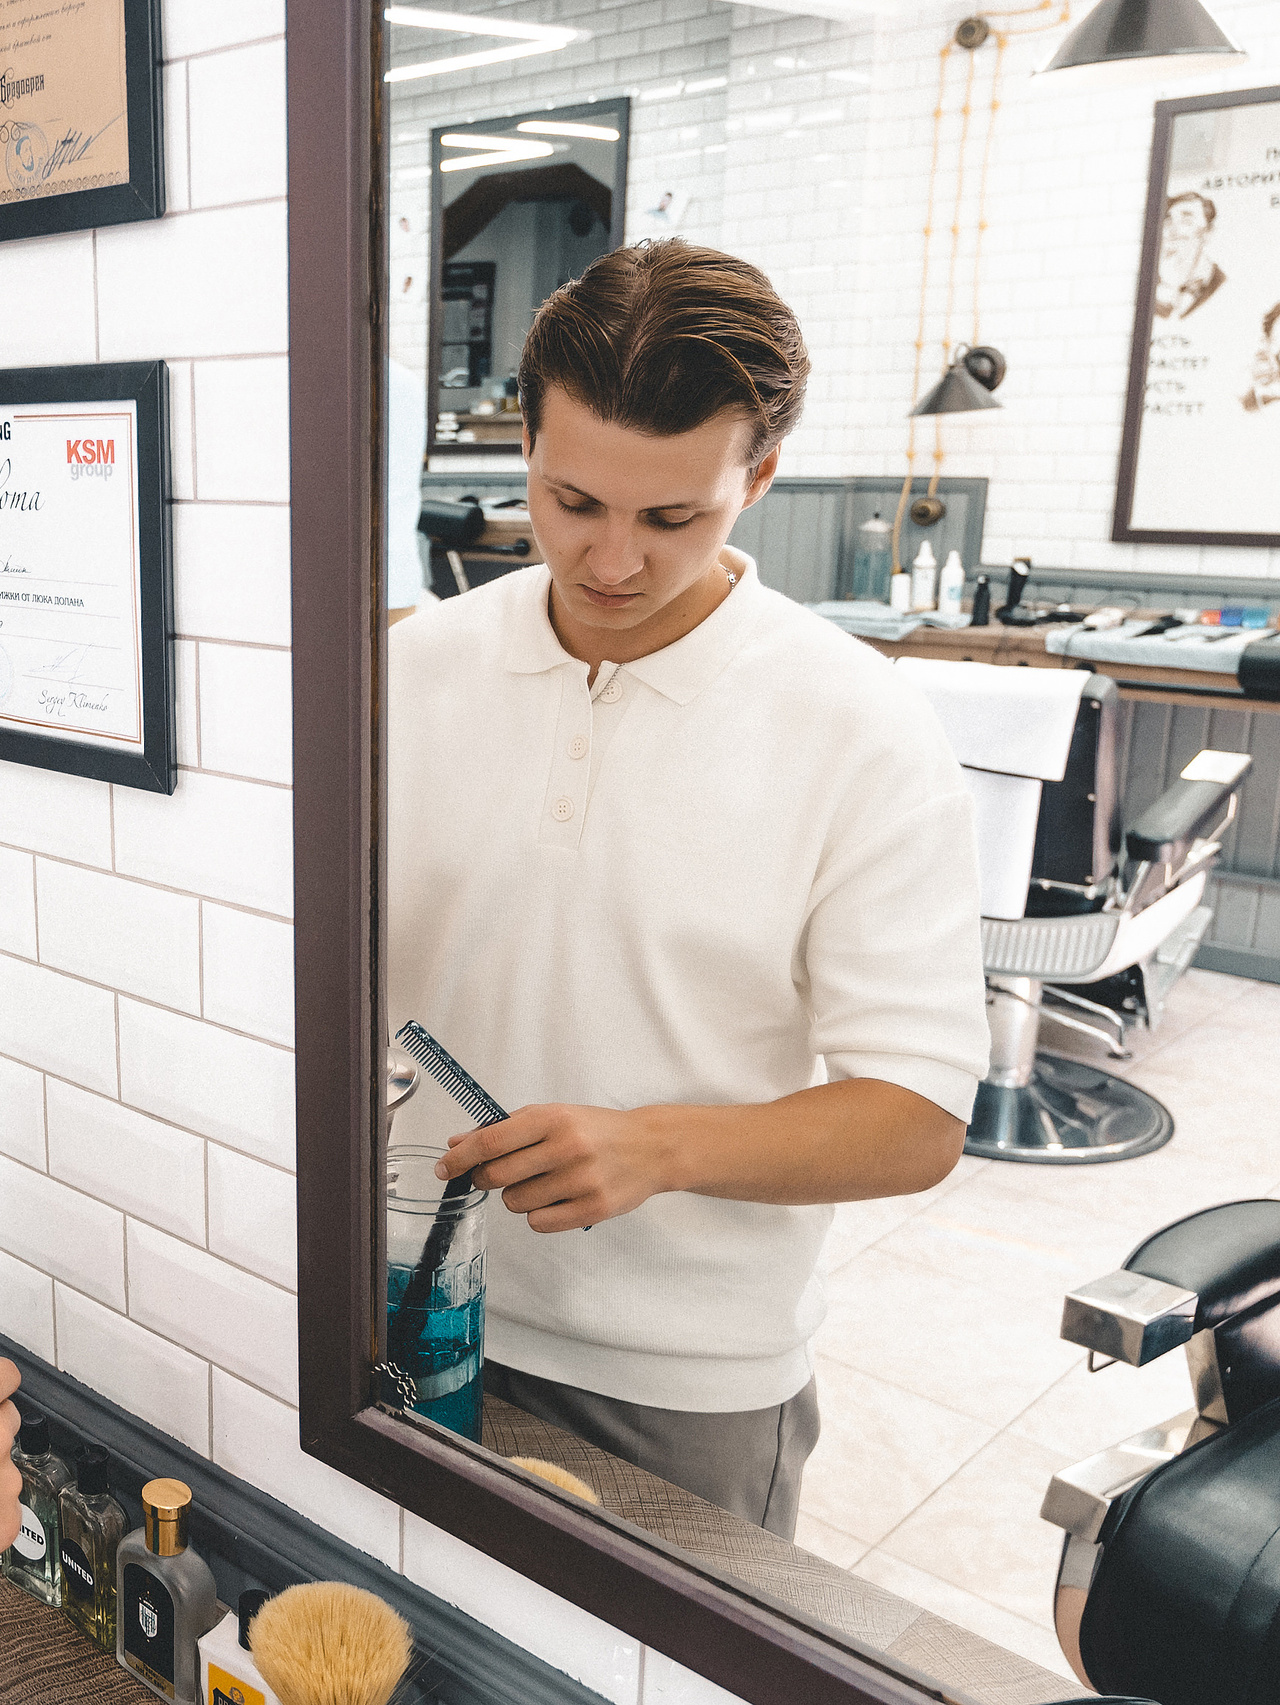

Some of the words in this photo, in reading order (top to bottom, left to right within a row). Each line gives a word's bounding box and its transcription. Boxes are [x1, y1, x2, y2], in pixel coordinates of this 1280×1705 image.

[66, 439, 115, 466] KSM
[70, 462, 113, 482] group
[20, 592, 31, 602] ОТ
[31, 594, 53, 605] ЛЮКА
[54, 596, 85, 608] ДОЛАНА
[20, 1524, 45, 1546] ITED
[61, 1549, 94, 1586] UNITED
